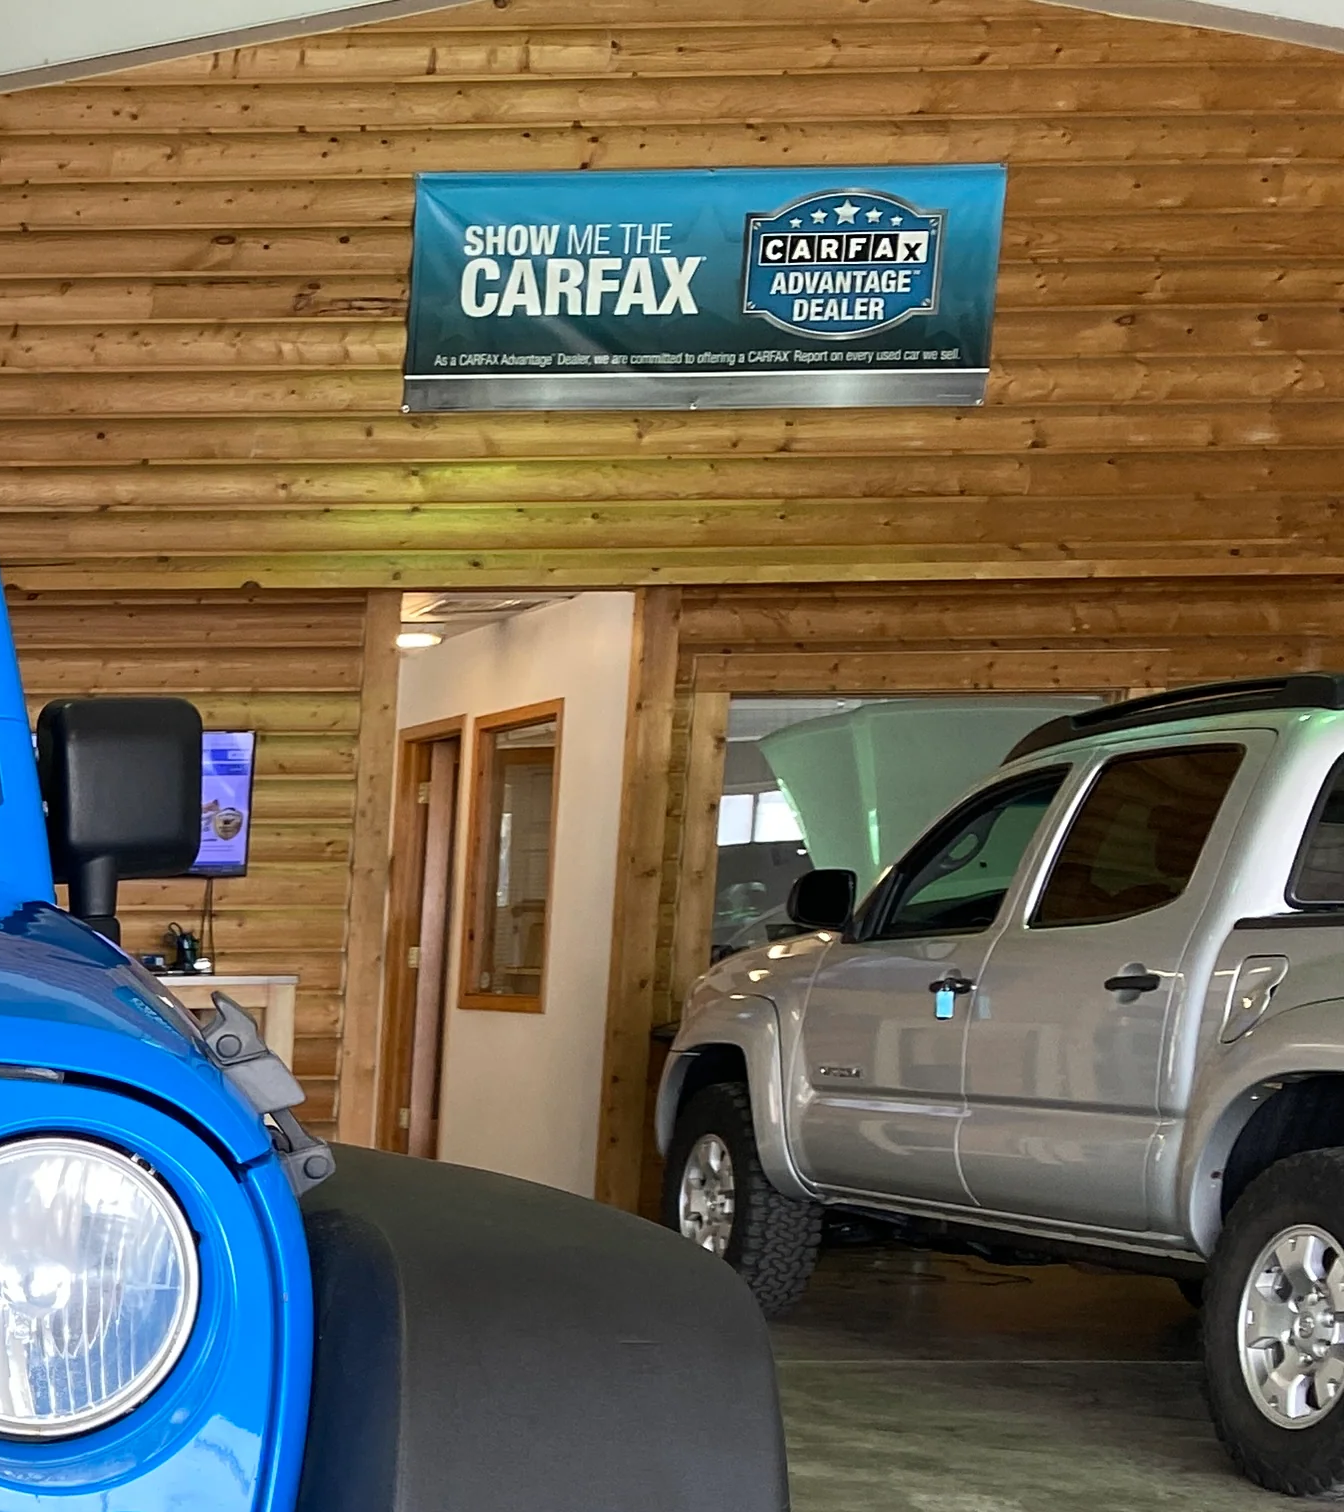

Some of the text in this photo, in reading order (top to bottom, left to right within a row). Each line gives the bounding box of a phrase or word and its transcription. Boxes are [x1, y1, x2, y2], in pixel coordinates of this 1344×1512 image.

[463, 222, 673, 256] SHOW ME THE
[764, 236, 923, 263] CARFAX
[460, 255, 702, 318] CARFAX
[769, 268, 912, 295] ADVANTAGE
[792, 296, 885, 322] DEALER
[433, 353, 448, 367] As
[450, 356, 457, 367] a
[458, 353, 500, 367] CARFAX
[557, 353, 592, 367] Dealer,
[594, 354, 609, 366] we
[611, 354, 628, 365] are
[630, 352, 683, 365] committed
[684, 352, 695, 365] to
[697, 350, 735, 367] offering
[738, 353, 745, 364] a
[747, 350, 789, 364] CARFAX
[793, 349, 828, 365] Report
[830, 352, 843, 363] on
[845, 351, 874, 365] every
[876, 349, 902, 362] used
[903, 349, 919, 361] car
[922, 349, 937, 361] we
[940, 348, 961, 361] sell.
